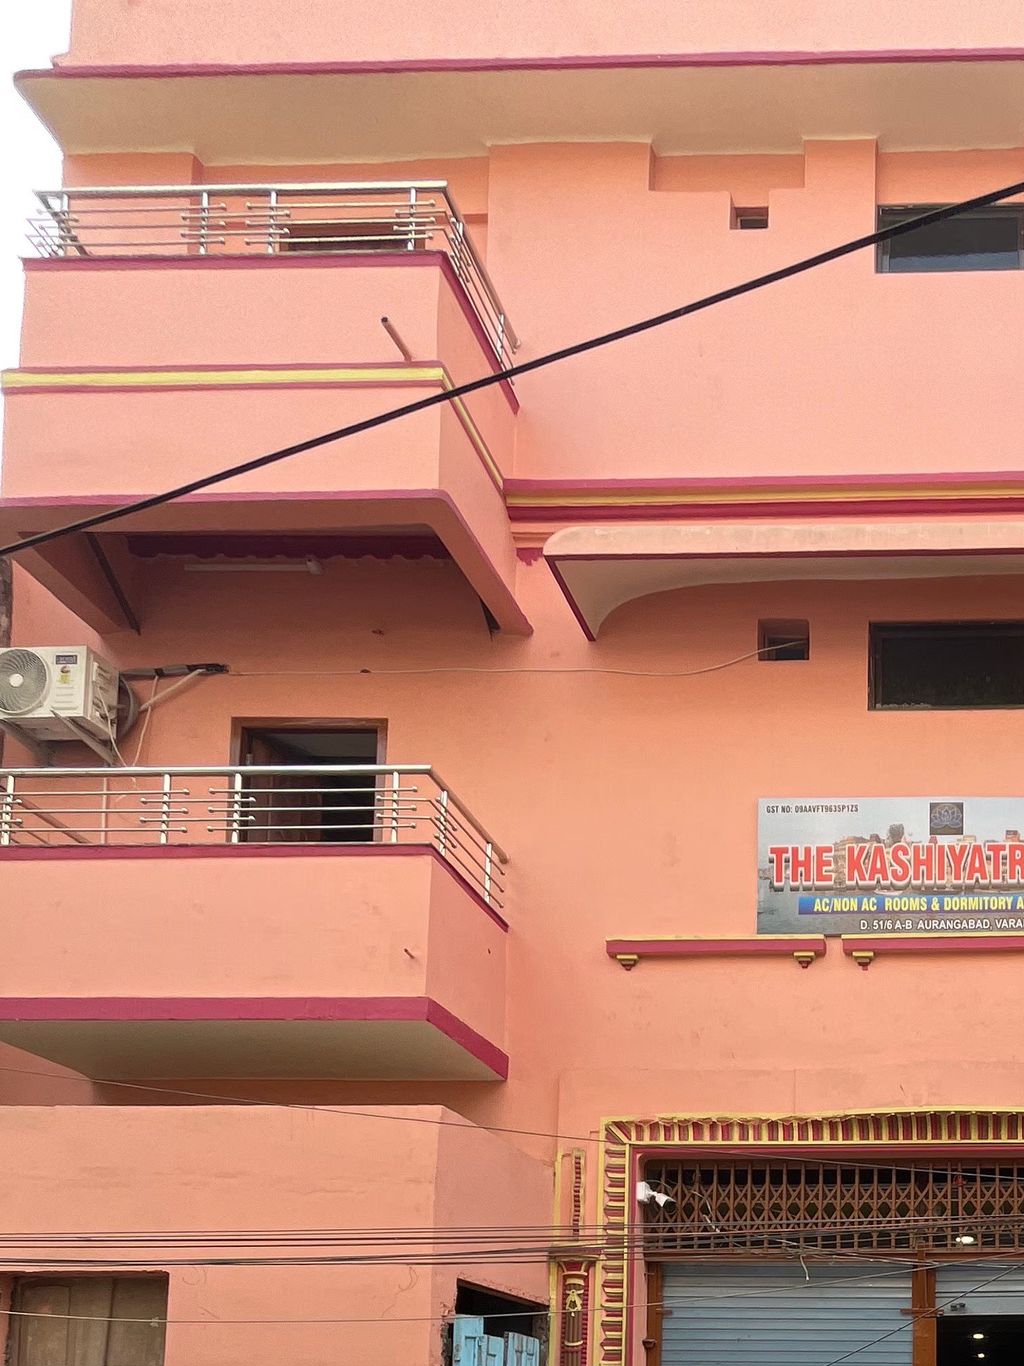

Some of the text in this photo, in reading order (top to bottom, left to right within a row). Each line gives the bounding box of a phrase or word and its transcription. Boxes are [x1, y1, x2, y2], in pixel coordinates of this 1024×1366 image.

[766, 805, 779, 814] GST
[781, 805, 793, 814] NO:
[768, 845, 834, 886] THE
[813, 897, 858, 912] AC/NON
[861, 897, 877, 912] AC
[884, 897, 928, 911] ROOMS
[931, 897, 940, 911] &
[943, 896, 1014, 911] DORMITORY
[860, 920, 870, 930] D.
[873, 919, 892, 930] 51/6
[894, 919, 912, 929] A-B
[917, 918, 992, 930] AURANGABAD,
